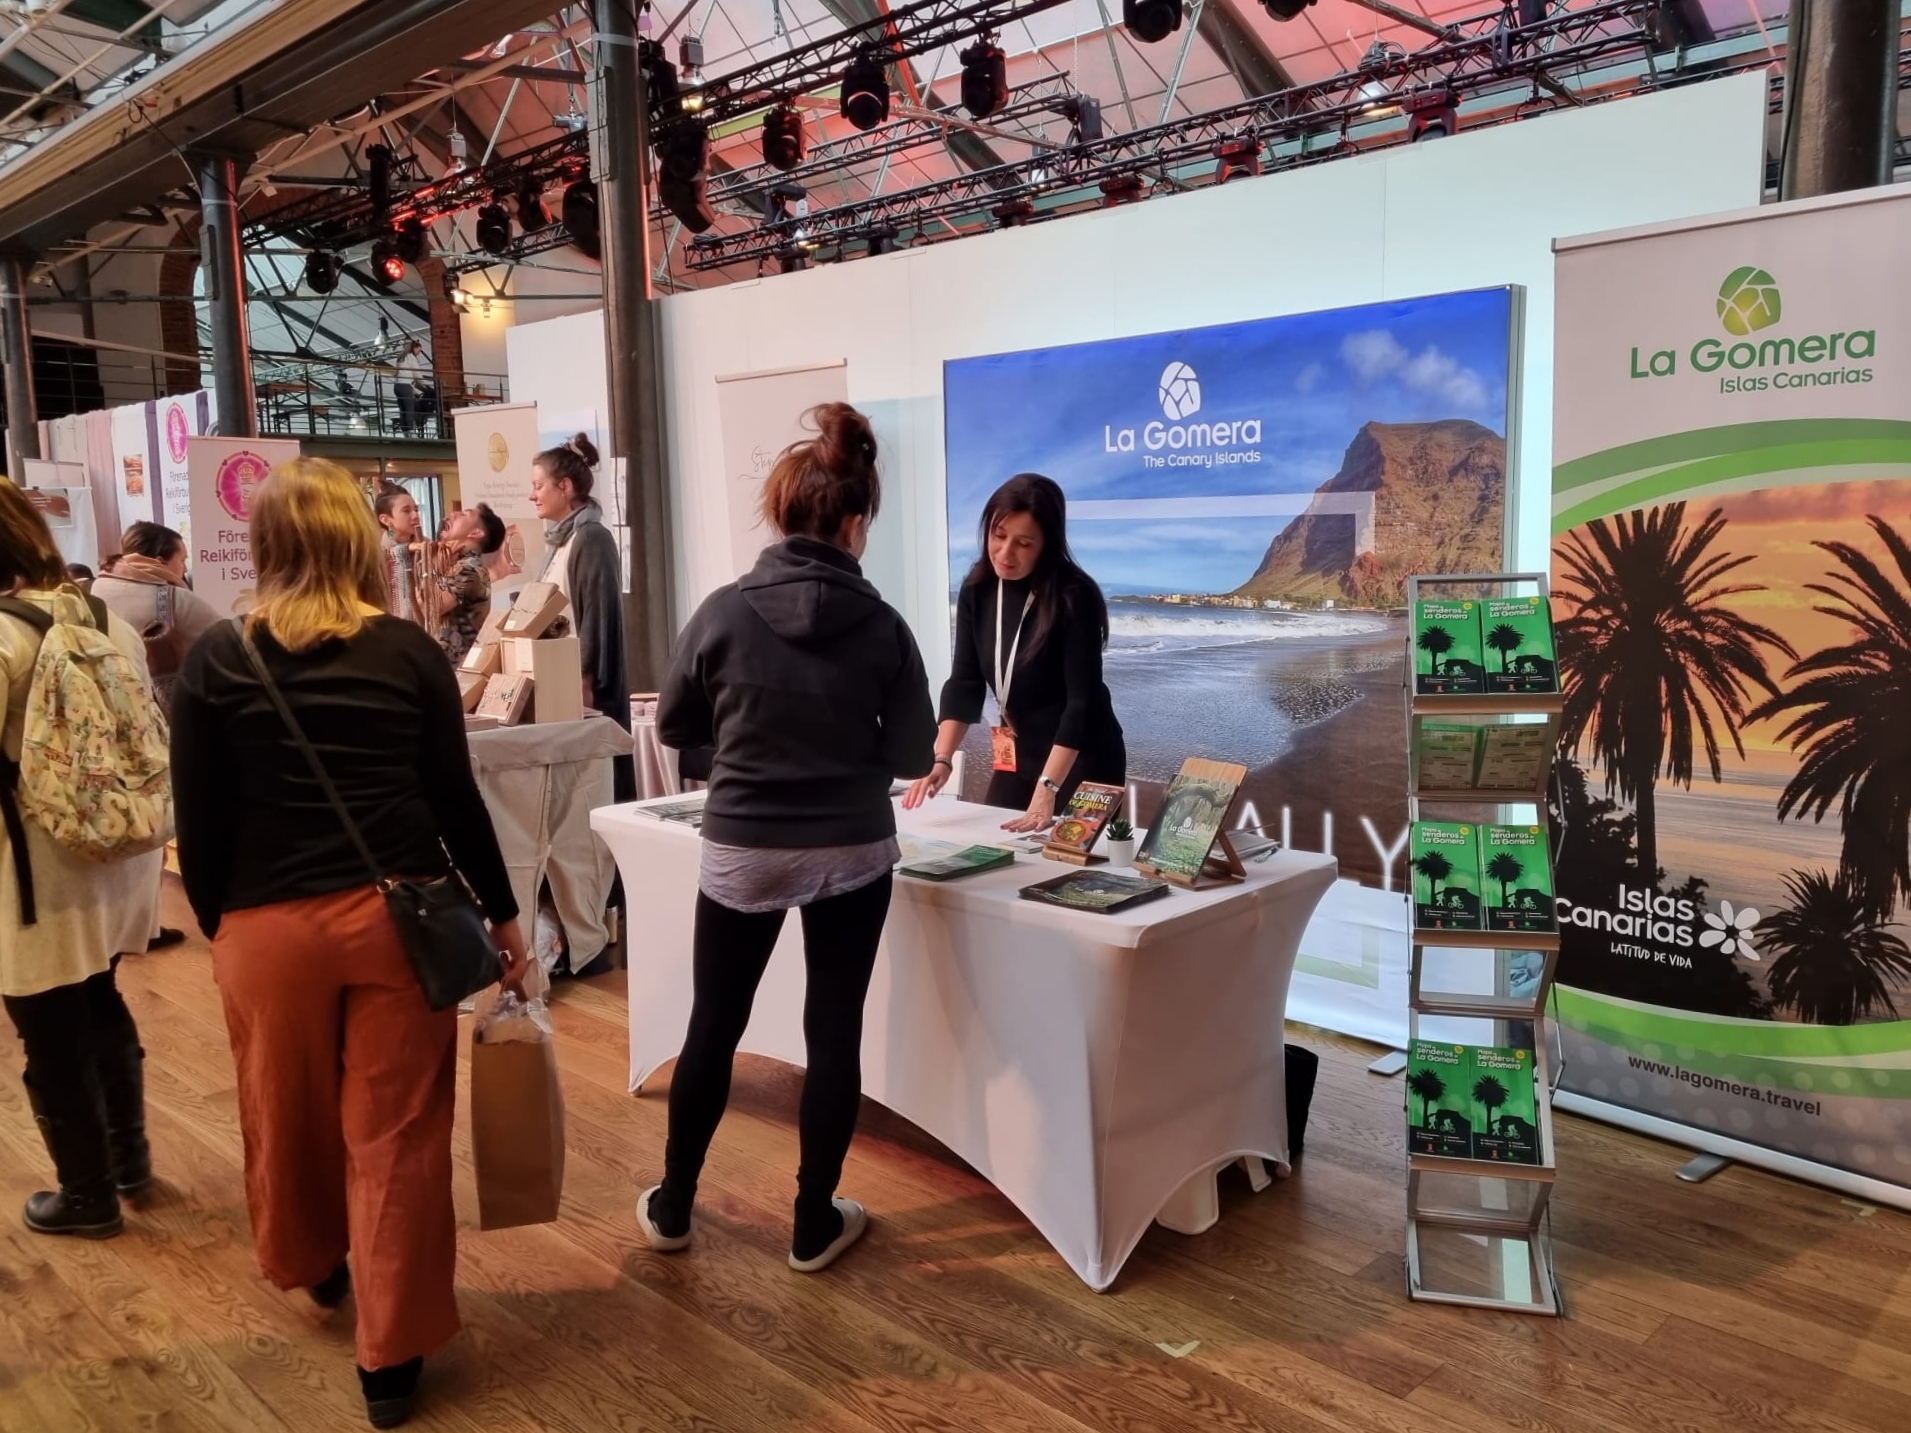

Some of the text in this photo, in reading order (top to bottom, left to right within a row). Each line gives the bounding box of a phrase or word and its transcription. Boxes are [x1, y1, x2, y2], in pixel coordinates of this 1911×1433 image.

[1630, 330, 1876, 379] La Gomera
[1720, 367, 1873, 394] Islas Canarias
[1105, 419, 1262, 452] La Gomera
[1143, 449, 1261, 469] The Canary Islands
[222, 568, 225, 580] i
[1490, 604, 1529, 612] senderos
[1501, 609, 1536, 617] Gomera
[1073, 791, 1113, 805] CUISINE
[1422, 831, 1459, 839] senderos
[1432, 837, 1465, 845] Gomera
[1490, 831, 1530, 839] senderos
[1618, 883, 1695, 921] Islas
[1555, 897, 1694, 947] Canarias
[1654, 951, 1667, 964] DE
[1668, 954, 1693, 969] VIDA
[1417, 1047, 1454, 1057] senderos
[1477, 1053, 1516, 1063] senderos
[1427, 1054, 1459, 1065] Gomera
[1488, 1061, 1521, 1070] Gomera
[1628, 1056, 1821, 1116] www.lagomera.travel
